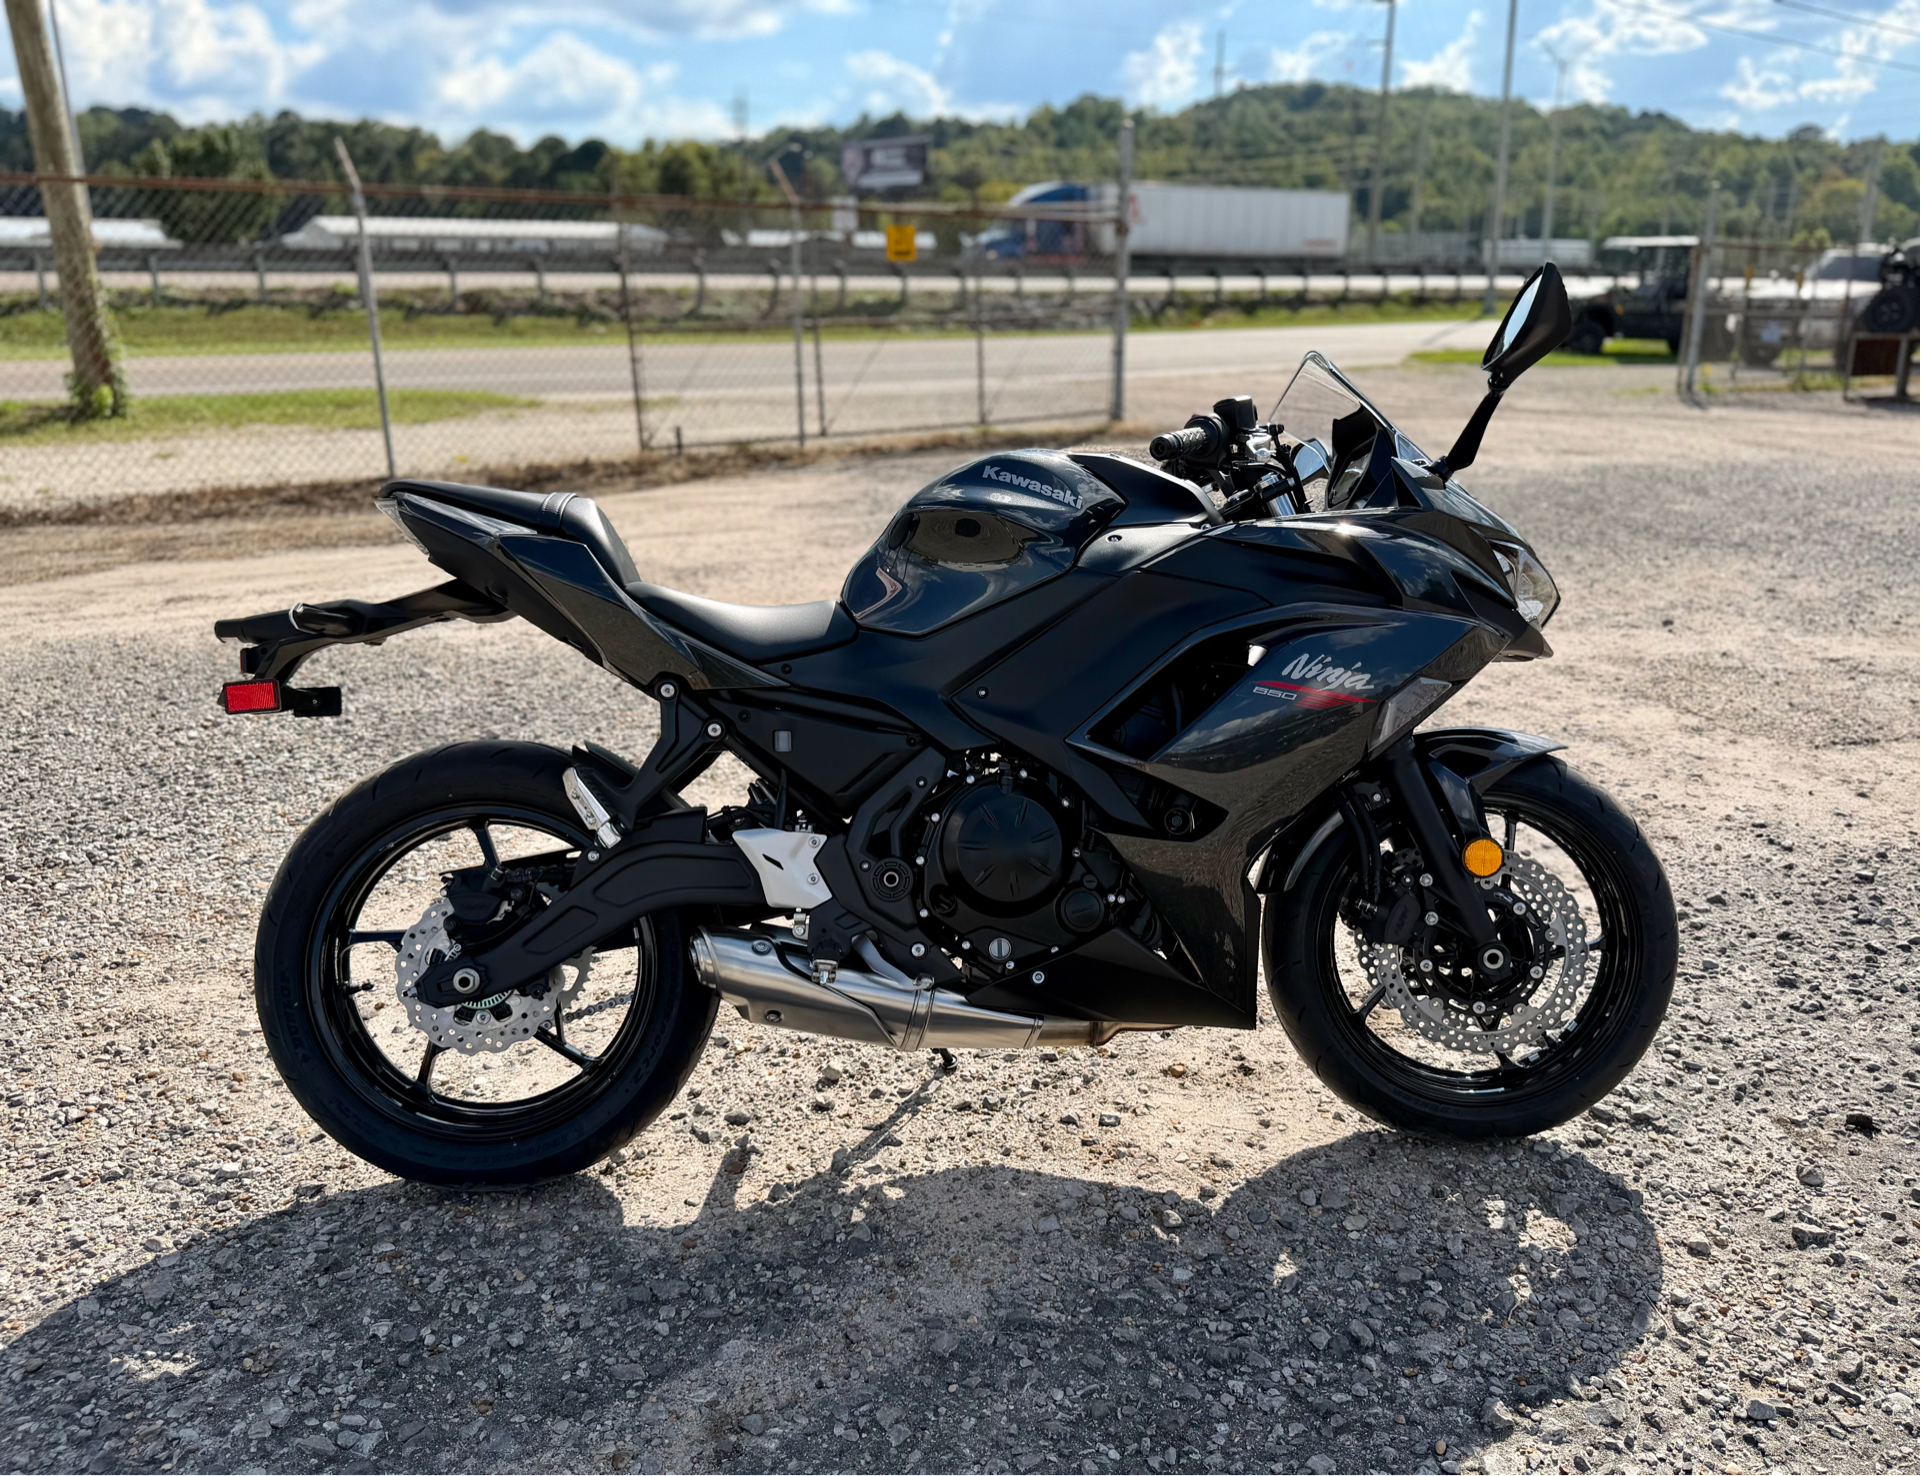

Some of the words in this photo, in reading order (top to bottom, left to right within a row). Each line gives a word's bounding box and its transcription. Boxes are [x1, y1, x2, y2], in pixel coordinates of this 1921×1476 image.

[982, 465, 1084, 510] Kawasaki
[1252, 686, 1298, 701] 650
[1281, 653, 1375, 692] Ninja
[279, 969, 305, 1050] DUNLOP
